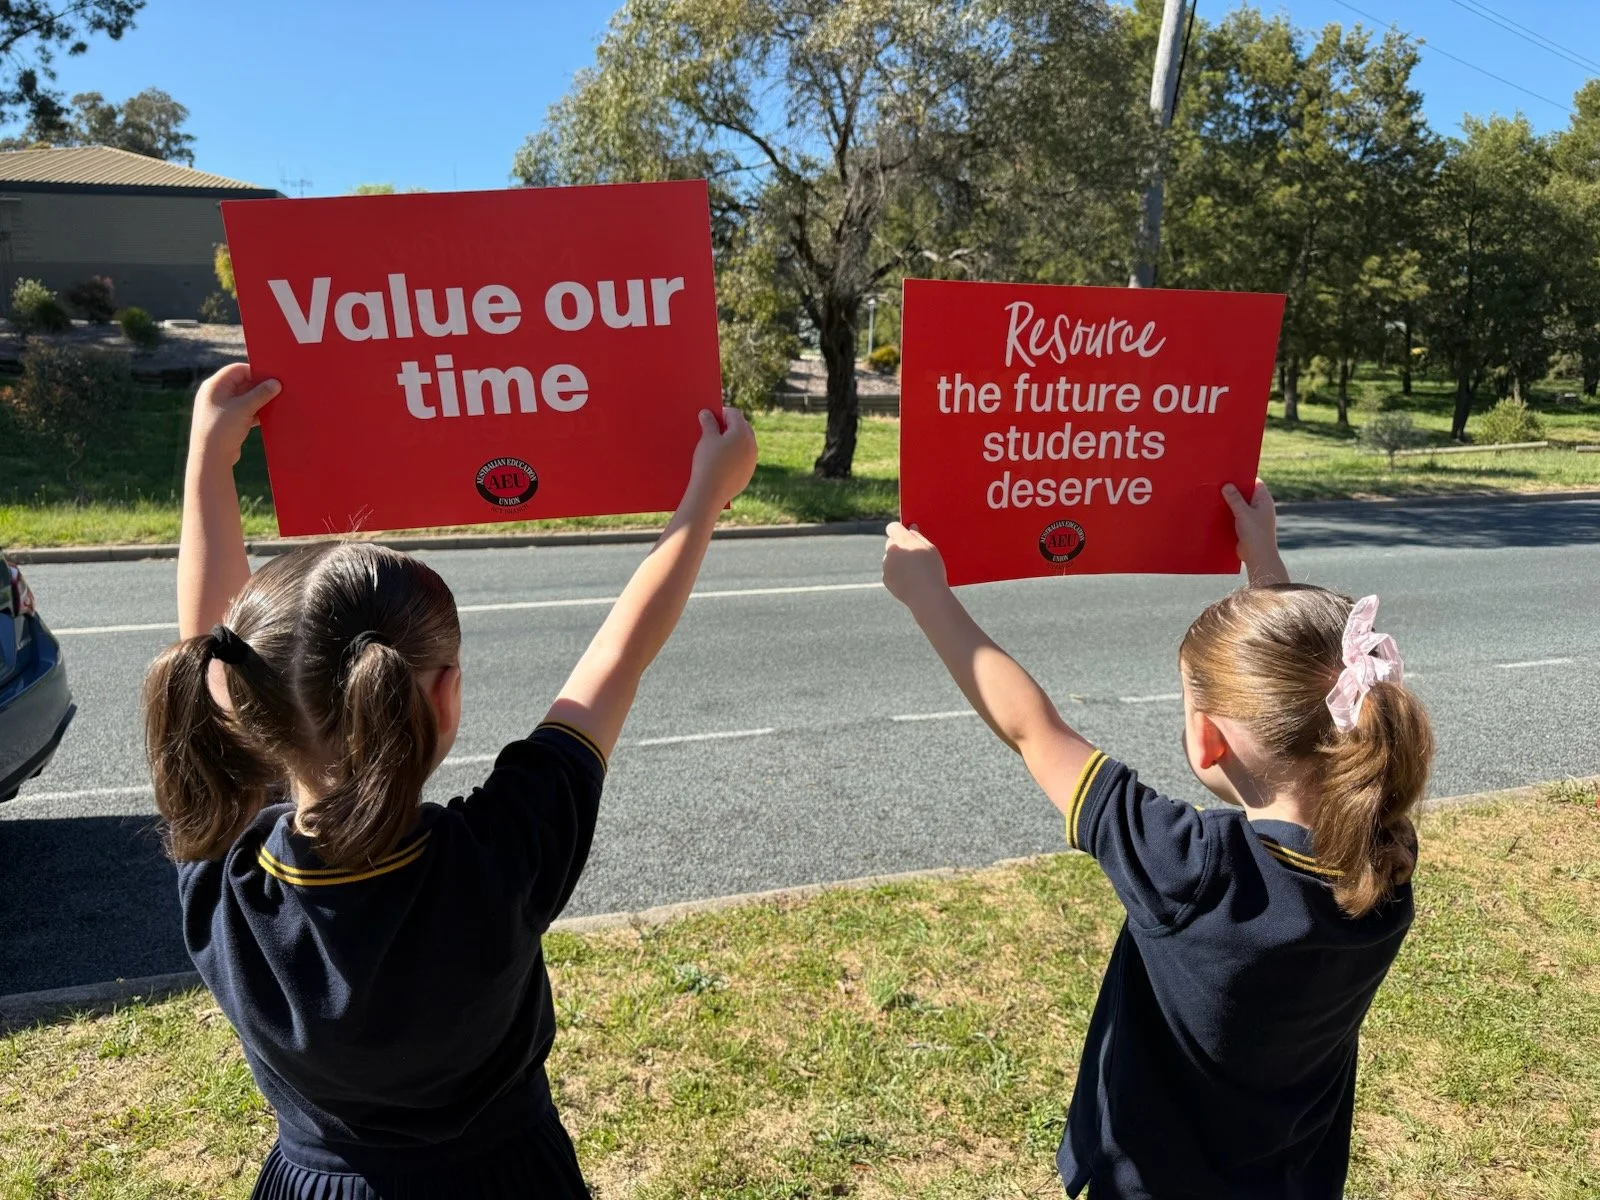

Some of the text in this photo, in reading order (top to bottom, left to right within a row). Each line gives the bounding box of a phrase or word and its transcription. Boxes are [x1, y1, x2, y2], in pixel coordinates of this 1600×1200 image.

[268, 274, 684, 343] Value our
[1005, 302, 1166, 367] Resource
[397, 355, 588, 419] time
[937, 373, 1228, 413] the future our
[983, 423, 1164, 461] students
[477, 459, 536, 485] AUSTRALIAN EDUCATION
[488, 474, 525, 489] AEU
[987, 470, 1152, 508] deserve
[499, 497, 521, 505] UNION
[1040, 521, 1065, 543] AUSTRALIAN
[1050, 535, 1076, 547] AEU
